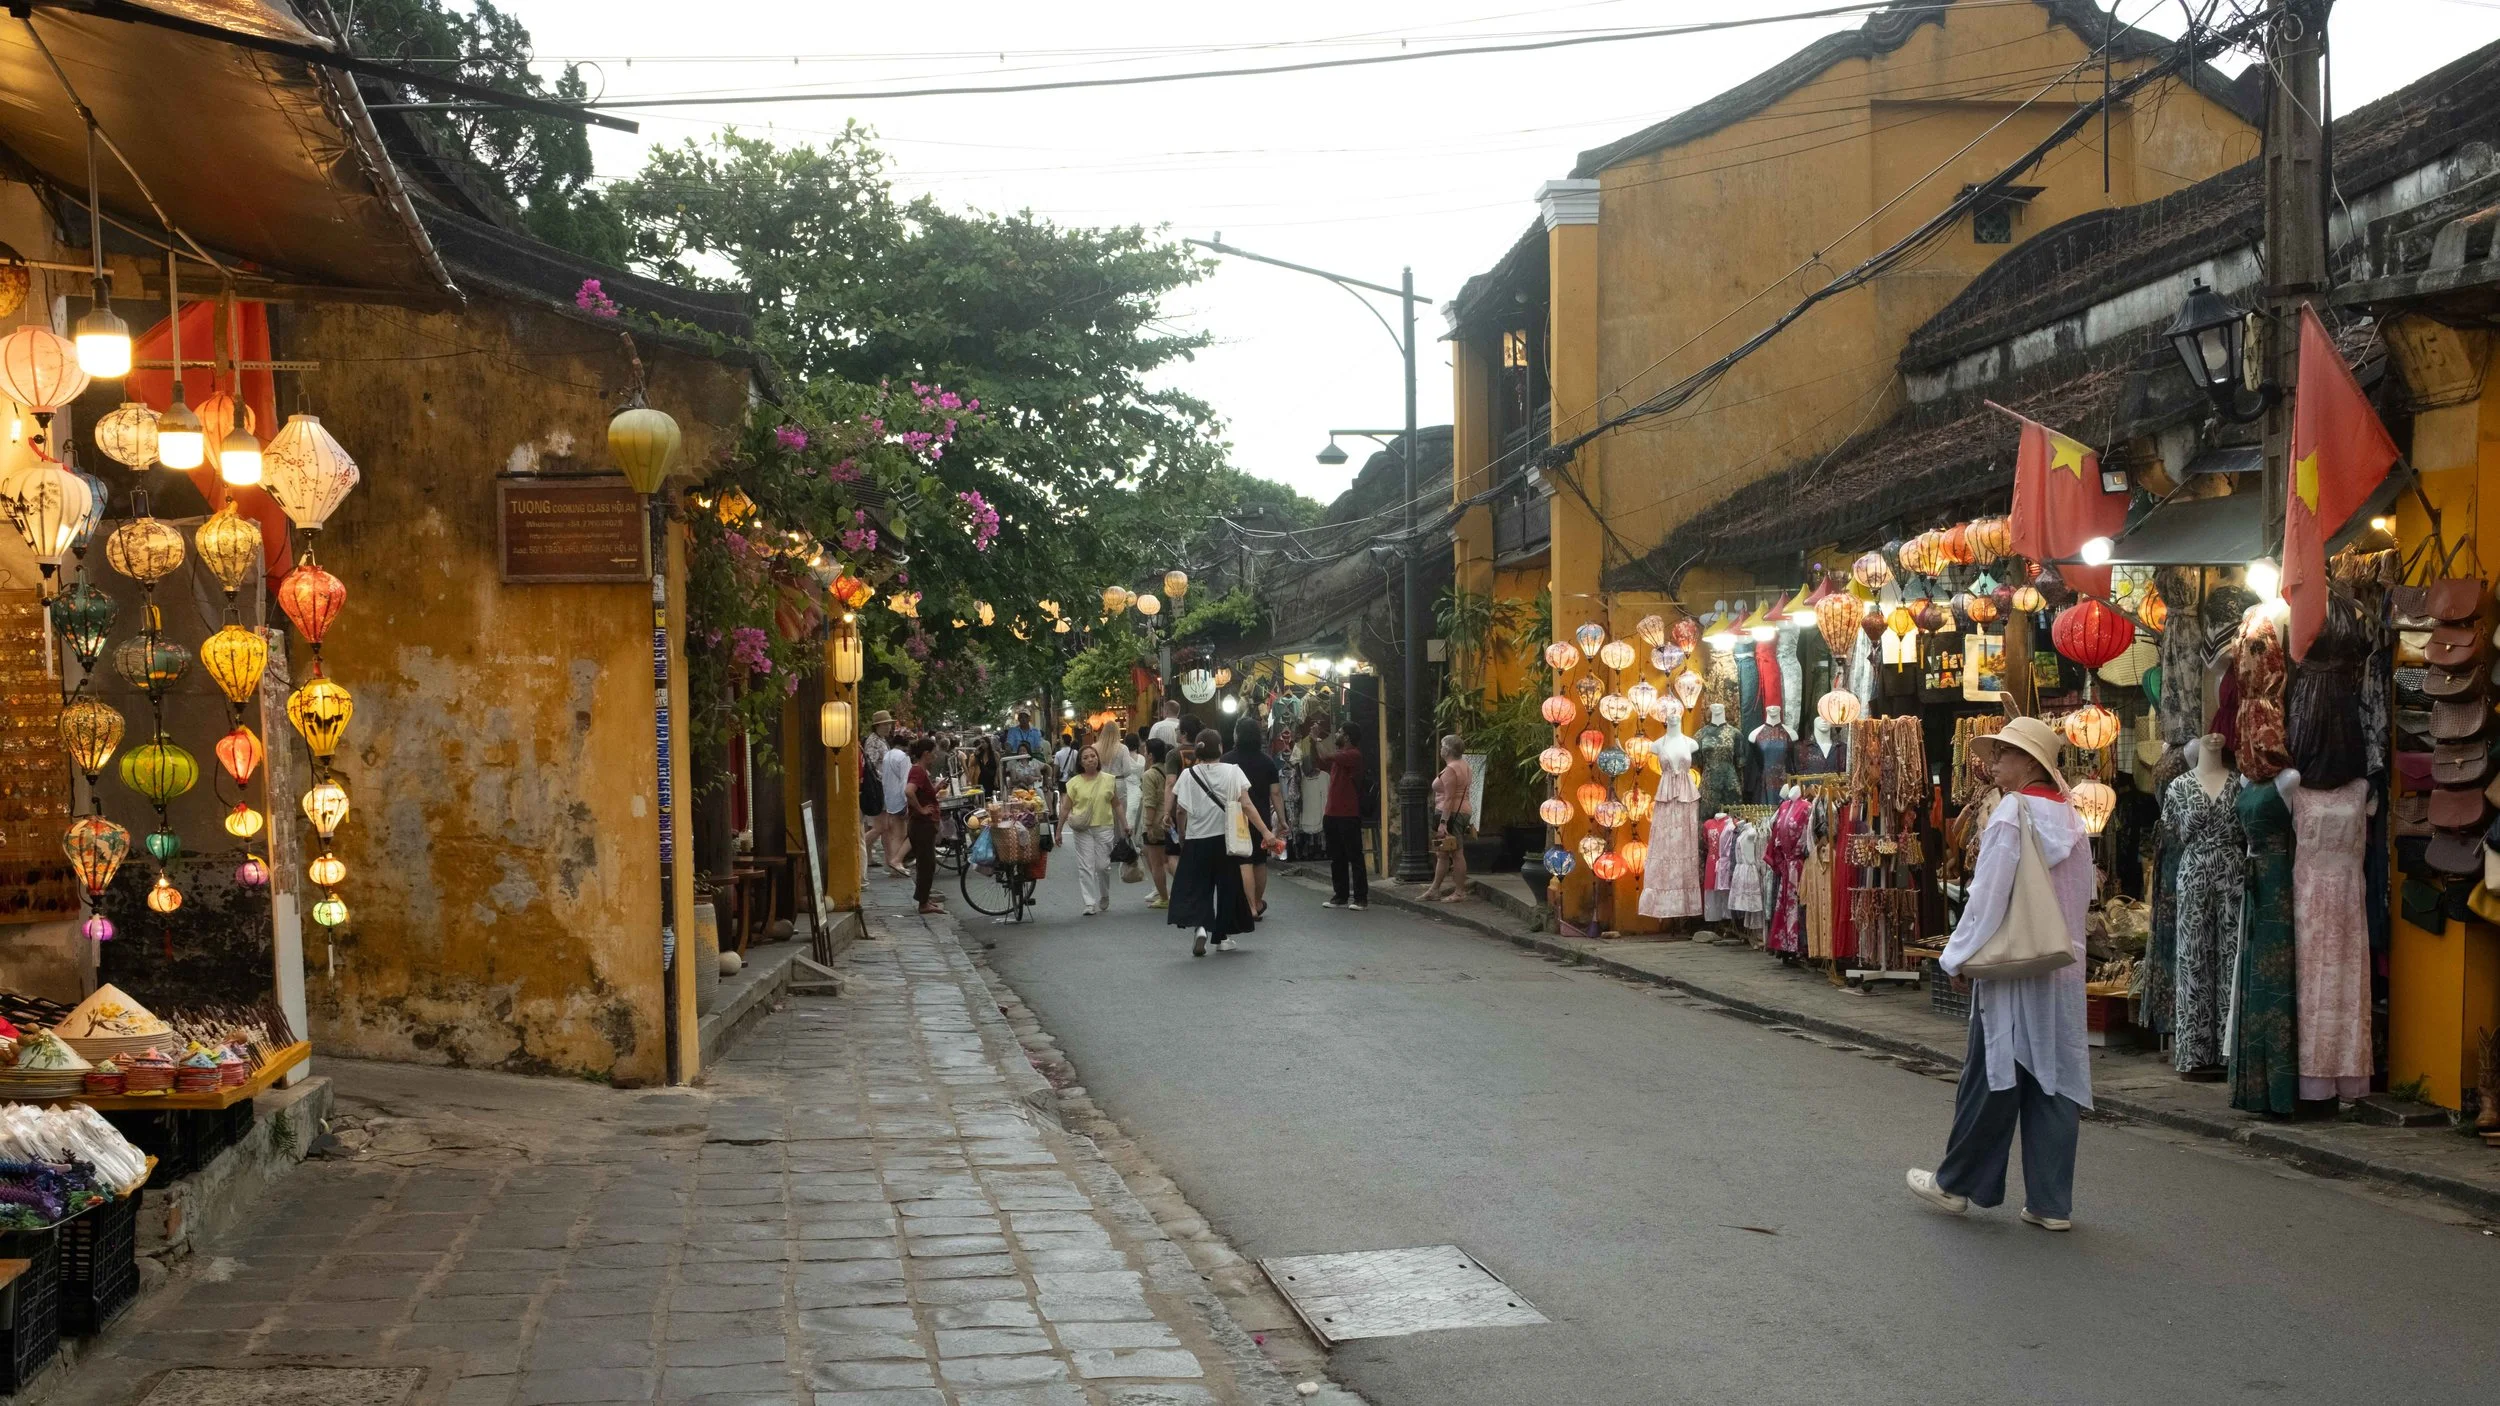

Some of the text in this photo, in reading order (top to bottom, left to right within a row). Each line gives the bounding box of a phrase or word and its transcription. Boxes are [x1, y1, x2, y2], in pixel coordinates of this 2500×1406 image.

[511, 500, 551, 514] TUONG
[553, 503, 585, 513] COOKING
[587, 503, 610, 513] CLASS
[625, 503, 637, 513] AN
[657, 758, 670, 777] 0933
